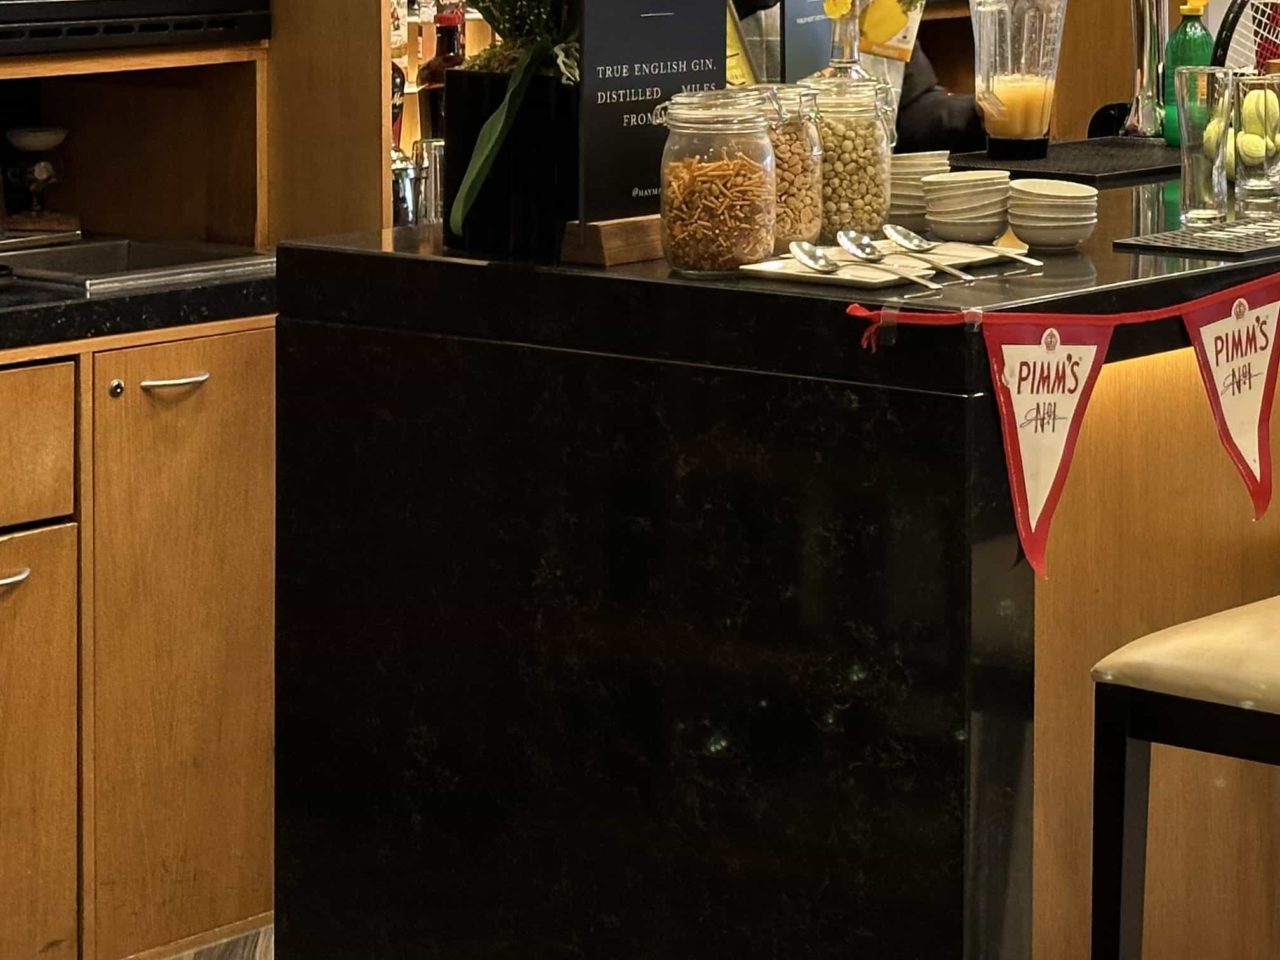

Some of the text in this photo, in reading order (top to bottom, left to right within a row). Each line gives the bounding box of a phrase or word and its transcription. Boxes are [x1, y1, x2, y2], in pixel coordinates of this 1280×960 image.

[596, 58, 717, 79] TRUE ENGLISH GIN.
[597, 87, 662, 104] DISTILLED
[1214, 315, 1269, 367] PIMM'S
[1016, 353, 1080, 395] PIMM'S
